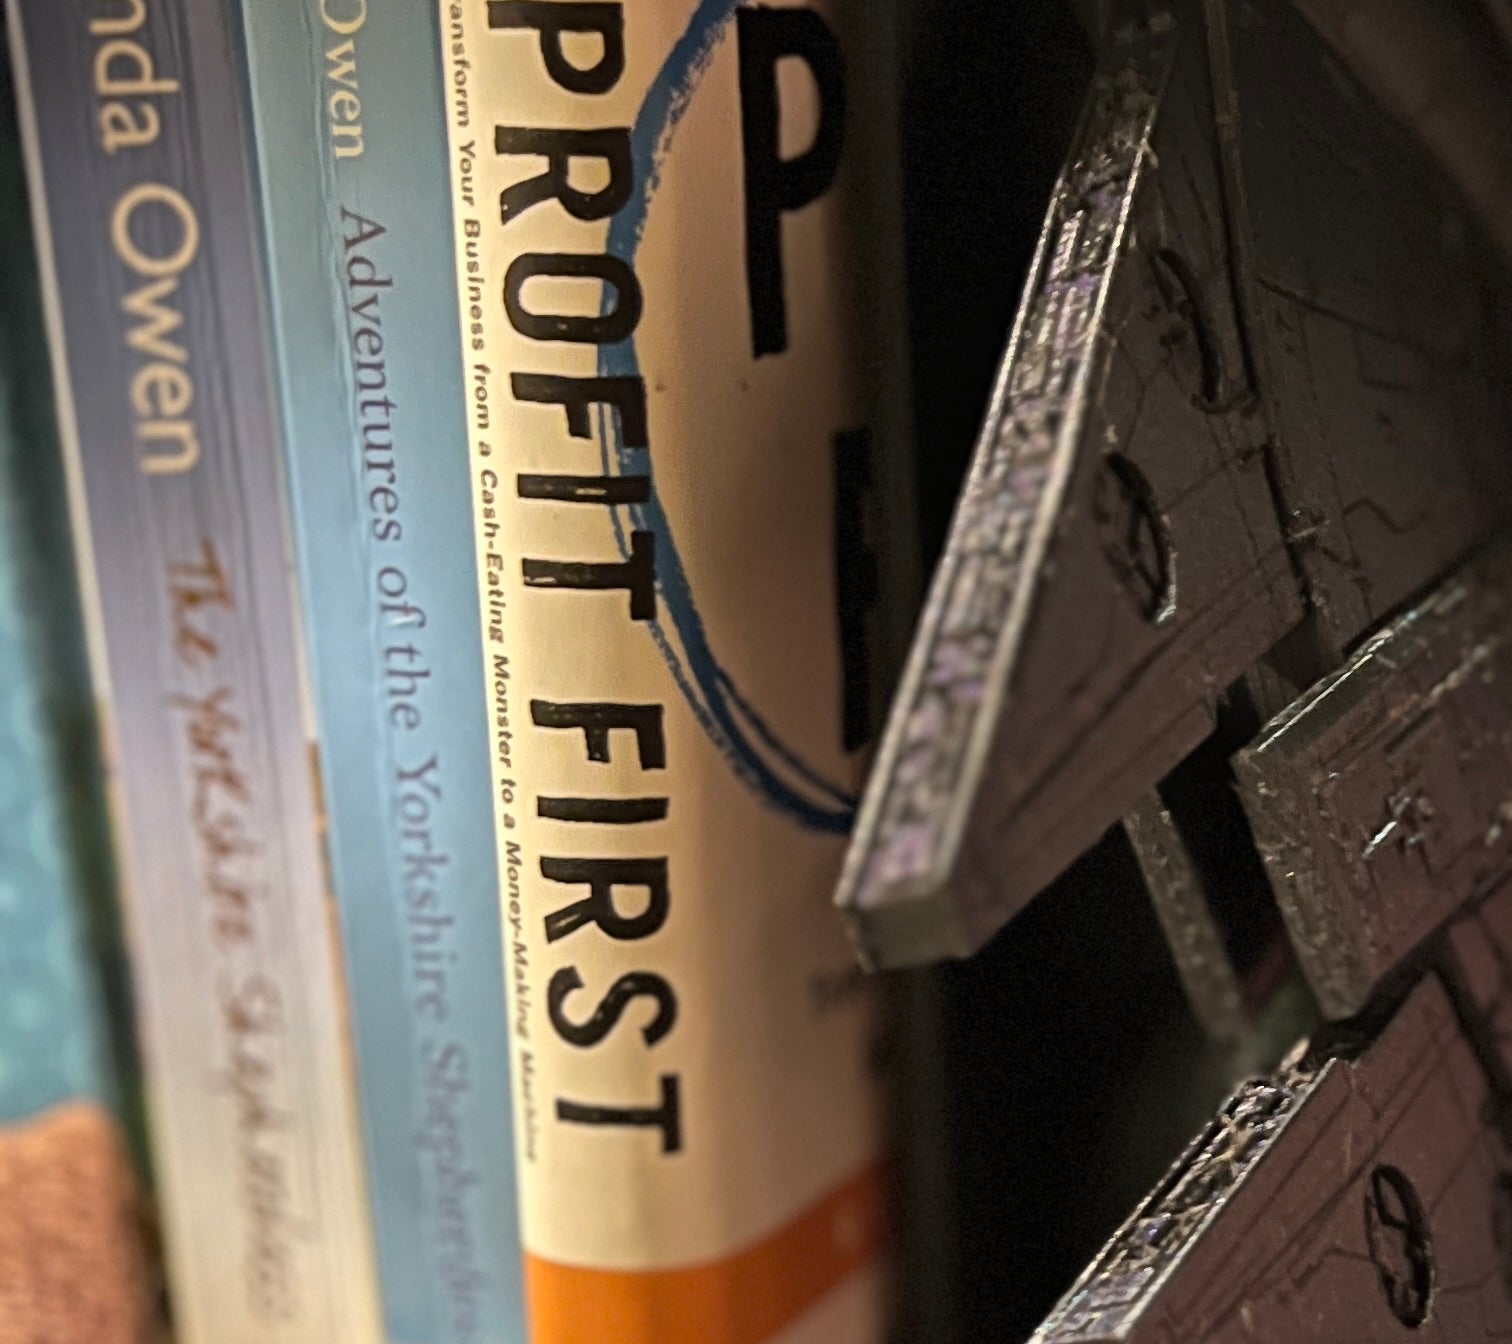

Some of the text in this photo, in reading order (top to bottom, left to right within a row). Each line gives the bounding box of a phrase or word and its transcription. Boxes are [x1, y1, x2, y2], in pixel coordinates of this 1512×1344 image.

[459, 140, 475, 208] Your
[111, 182, 200, 475] Owen
[464, 219, 485, 352] Business
[341, 207, 402, 542] Adventures
[474, 364, 489, 433] from
[479, 442, 491, 458] a
[166, 536, 237, 666] The
[378, 565, 426, 634] of
[481, 468, 505, 643] Cash-Eating
[383, 634, 431, 731] the
[492, 654, 513, 770] Monster
[501, 779, 514, 804] to
[504, 812, 517, 830] a
[397, 754, 460, 1022] Yorkshire
[505, 840, 530, 1039] Money-Making
[530, 698, 683, 1155] FIRST
